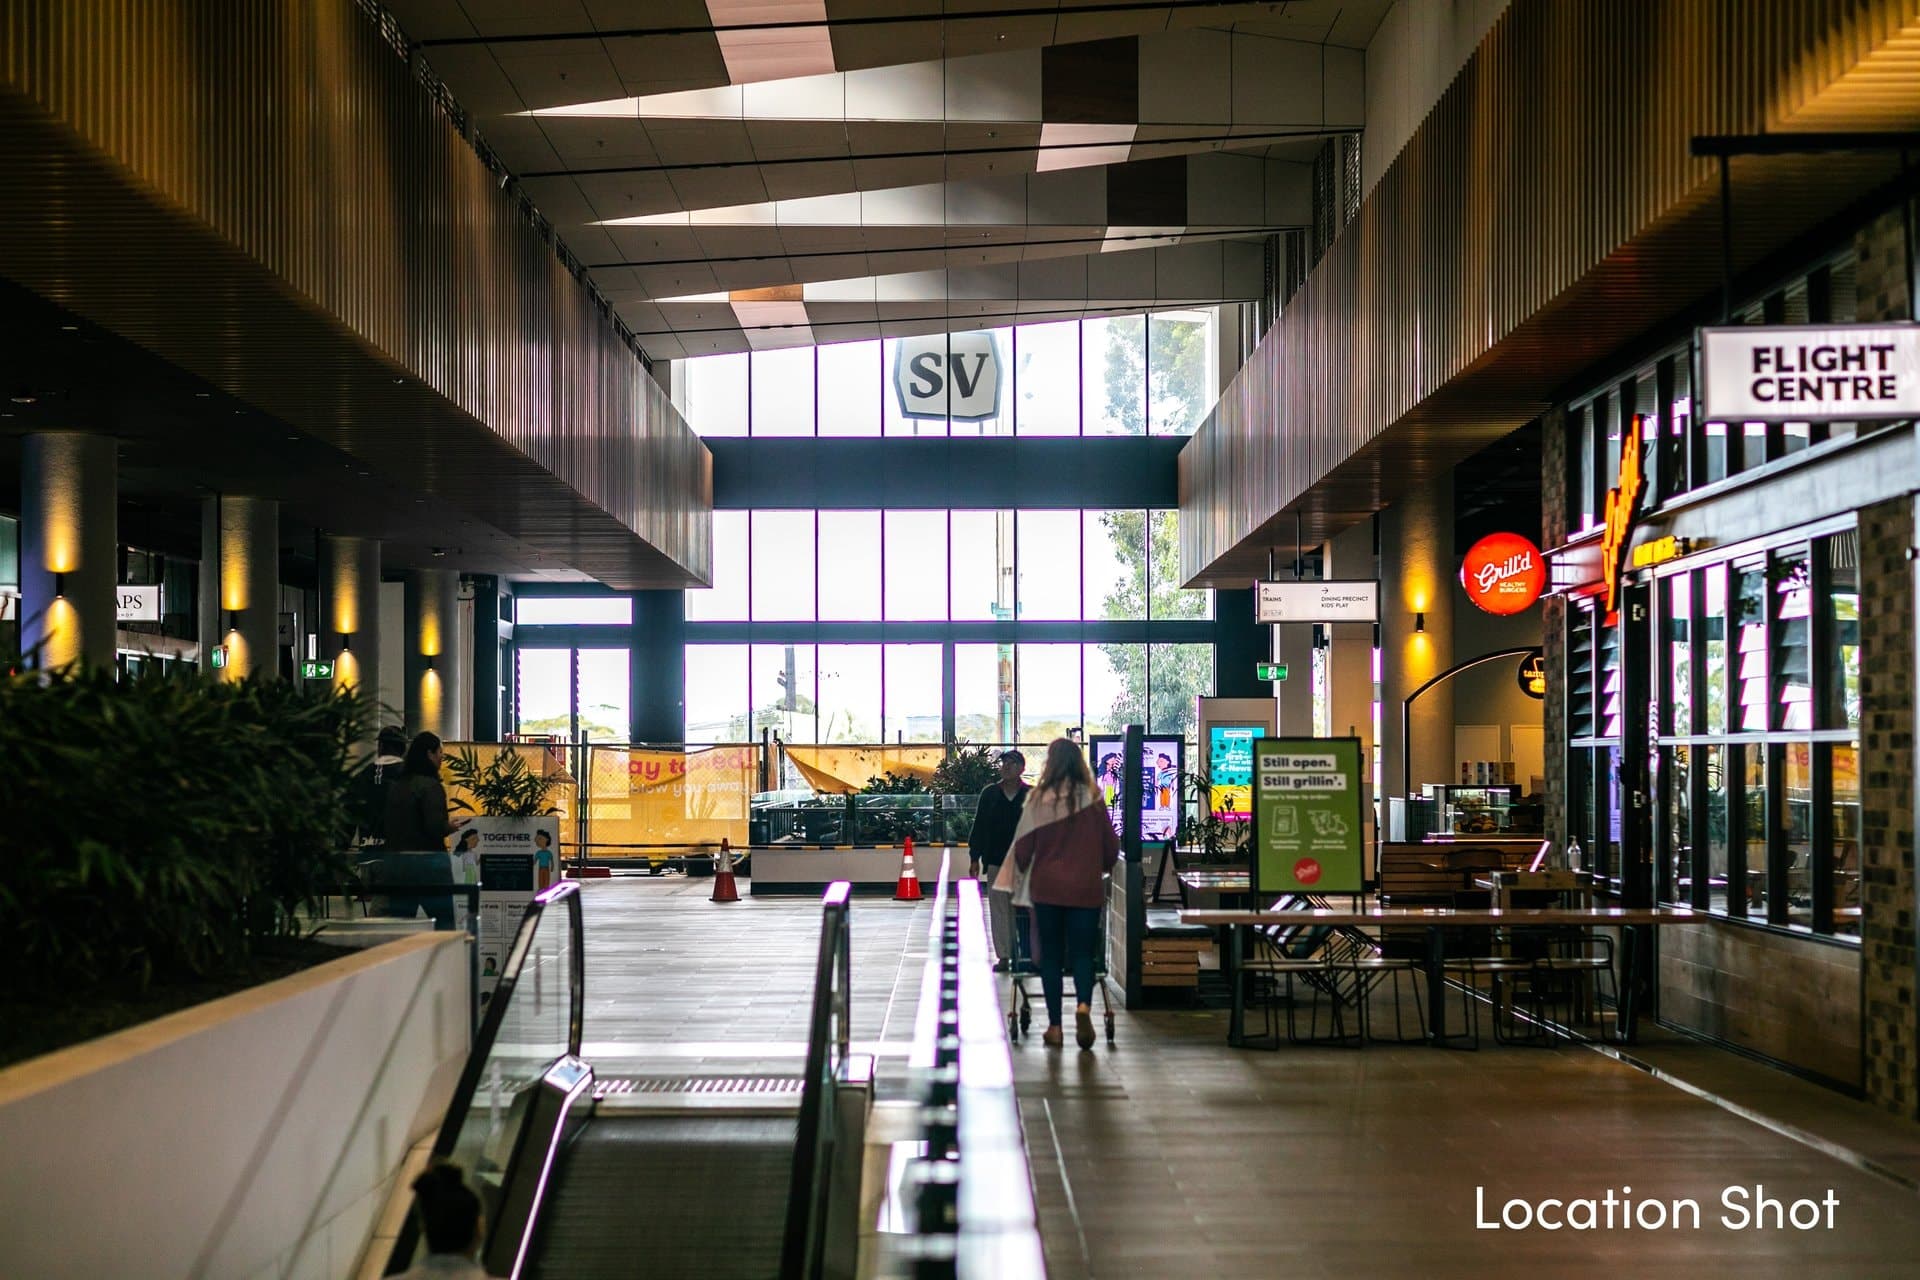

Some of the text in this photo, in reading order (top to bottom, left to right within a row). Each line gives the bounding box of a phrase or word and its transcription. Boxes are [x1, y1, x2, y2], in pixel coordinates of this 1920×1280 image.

[1753, 344, 1895, 373] FLIGHT
[910, 352, 989, 398] SV
[1752, 375, 1896, 402] CENTRE
[1474, 551, 1533, 593] Grill'd
[1263, 757, 1290, 768] Still
[1292, 758, 1332, 770] open.
[630, 782, 668, 794] blow
[672, 783, 704, 797] you
[1263, 775, 1342, 789] Still grillin'.
[483, 833, 531, 842] TOGETHER
